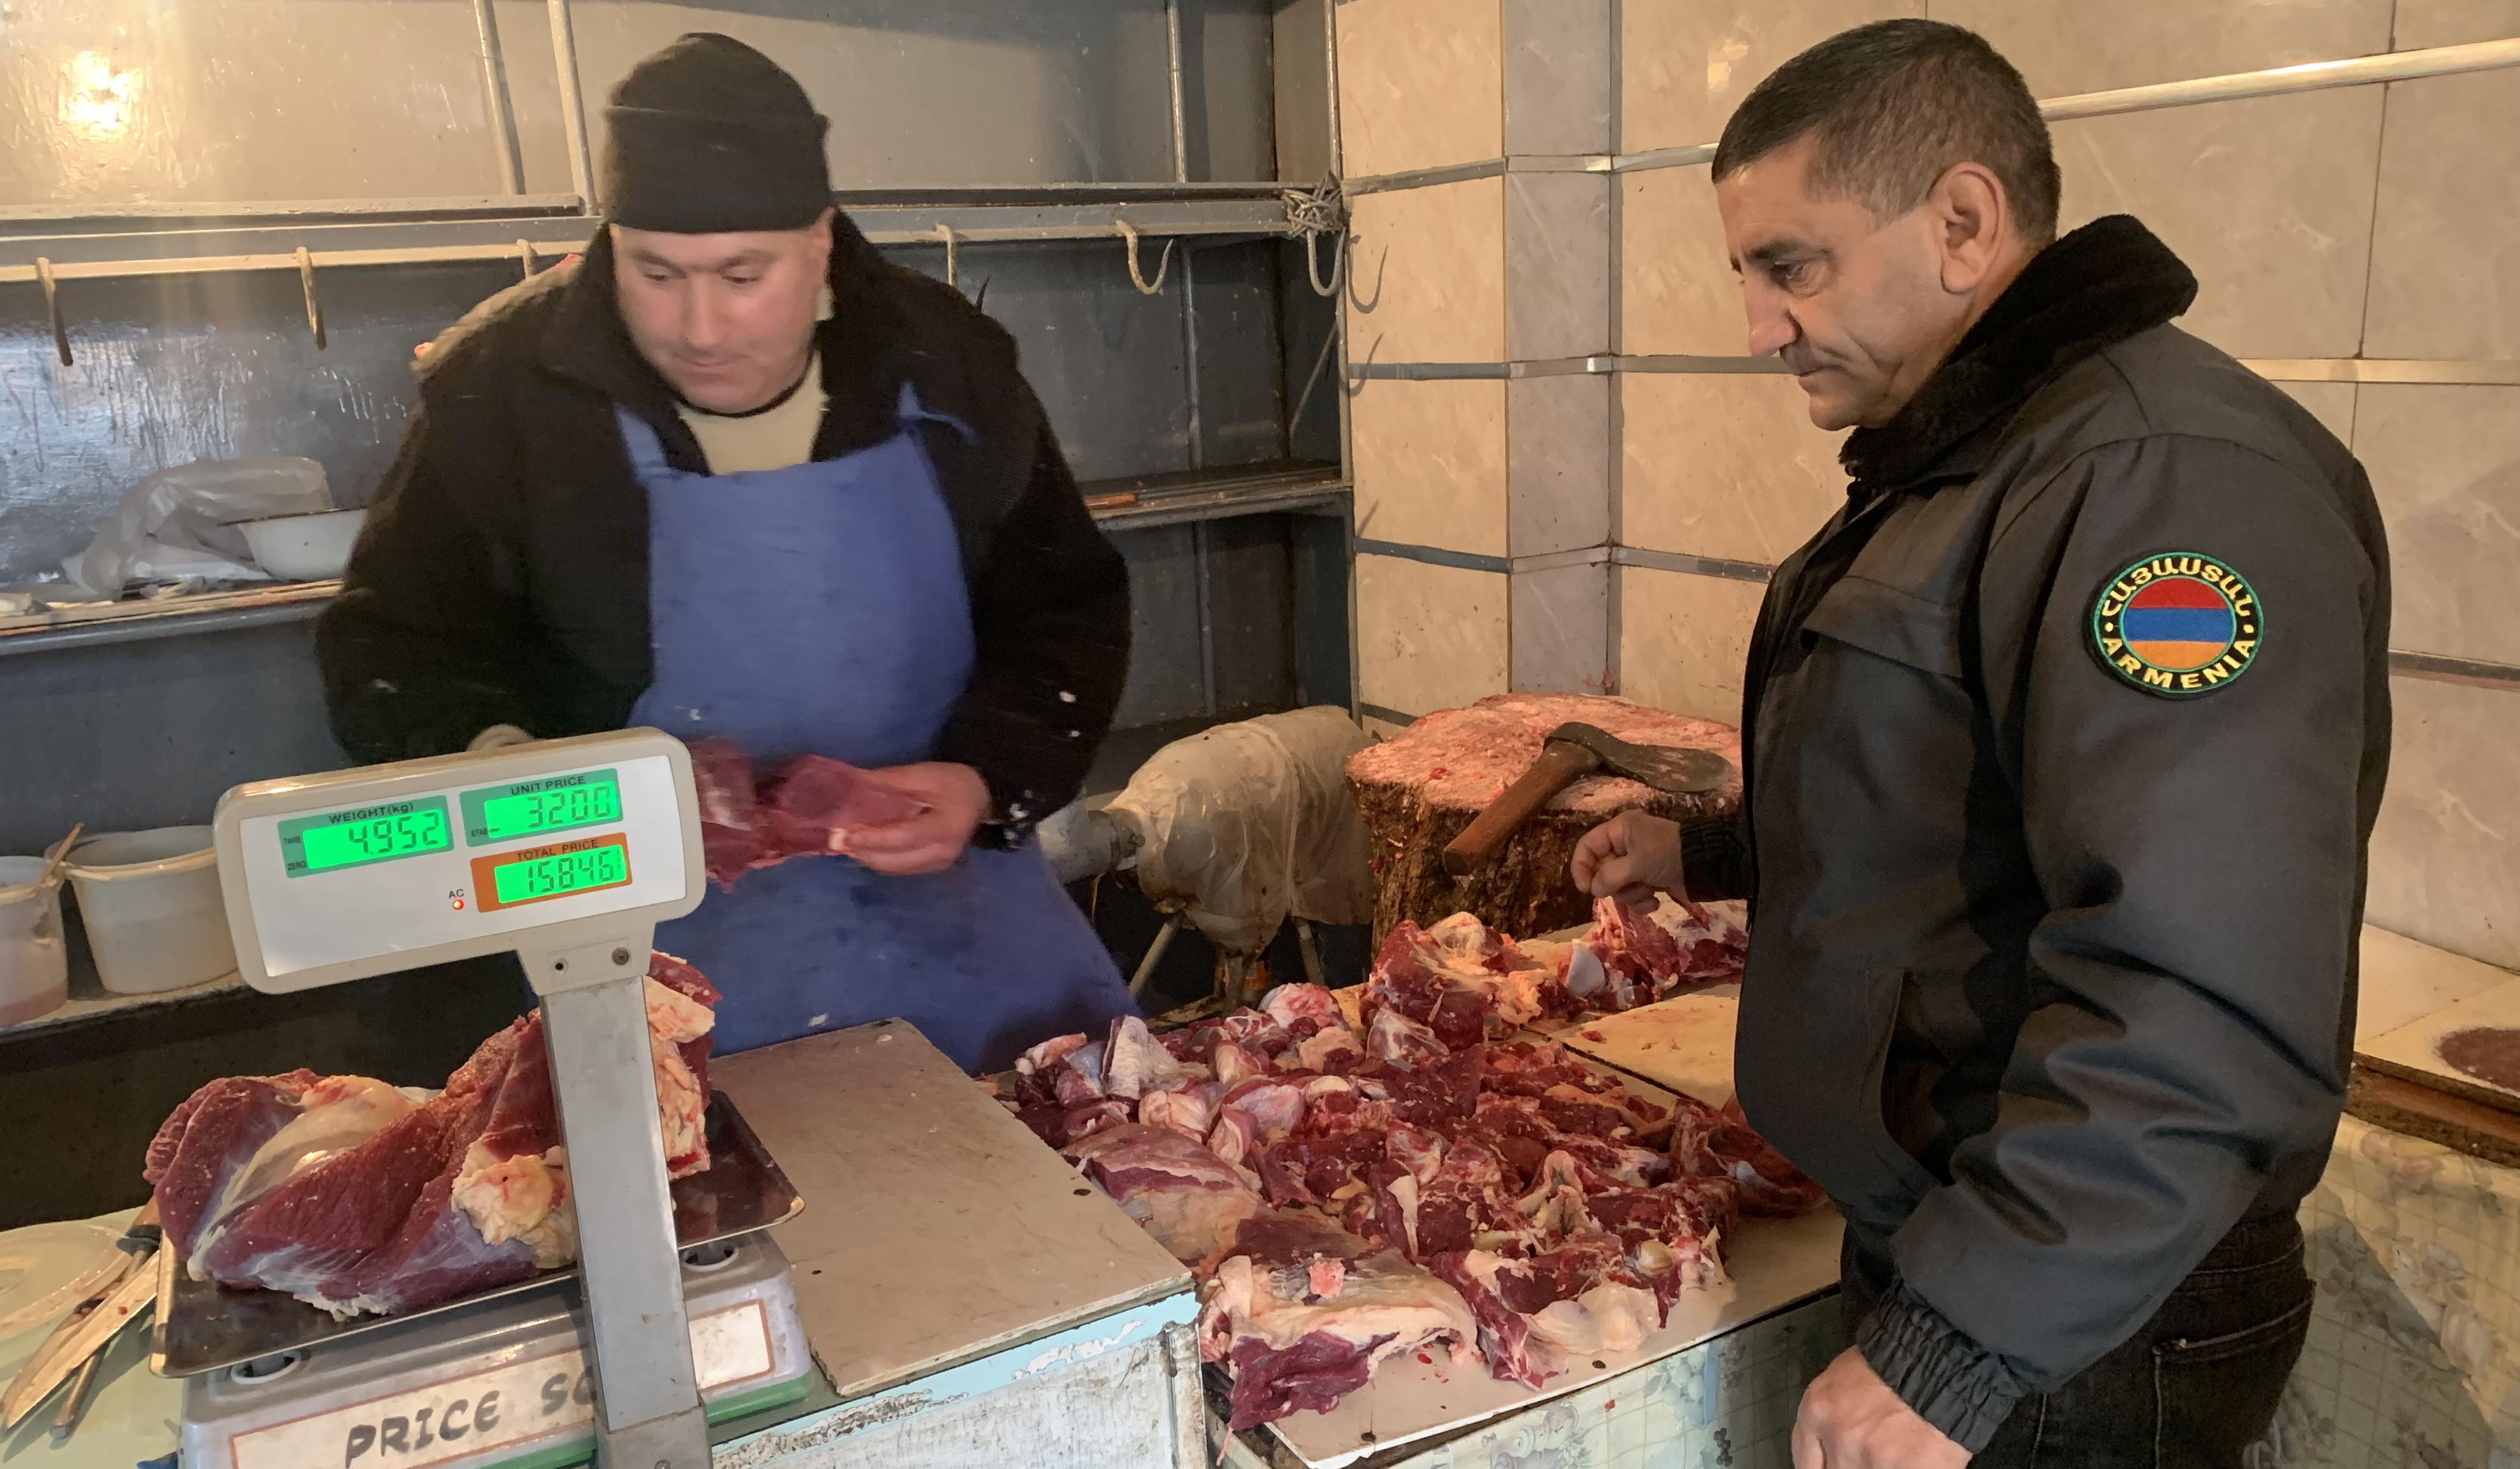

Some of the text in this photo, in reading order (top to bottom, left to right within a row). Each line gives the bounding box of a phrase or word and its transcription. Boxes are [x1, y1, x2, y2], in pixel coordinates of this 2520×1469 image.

[2102, 557, 2253, 616] ՀԱՅԱՍՏԱՆ
[2102, 638, 2256, 688] ARMENIA
[511, 776, 586, 796] UNIT PRICE
[527, 786, 611, 828] 3200
[329, 802, 414, 824] WEIGHT(kg)
[348, 812, 439, 855] 4.952
[287, 861, 306, 870] ZERO
[517, 840, 599, 861] TOTAL PRICE
[528, 850, 614, 893] 15846
[449, 888, 464, 899] AC
[346, 1390, 501, 1469] PRICE
